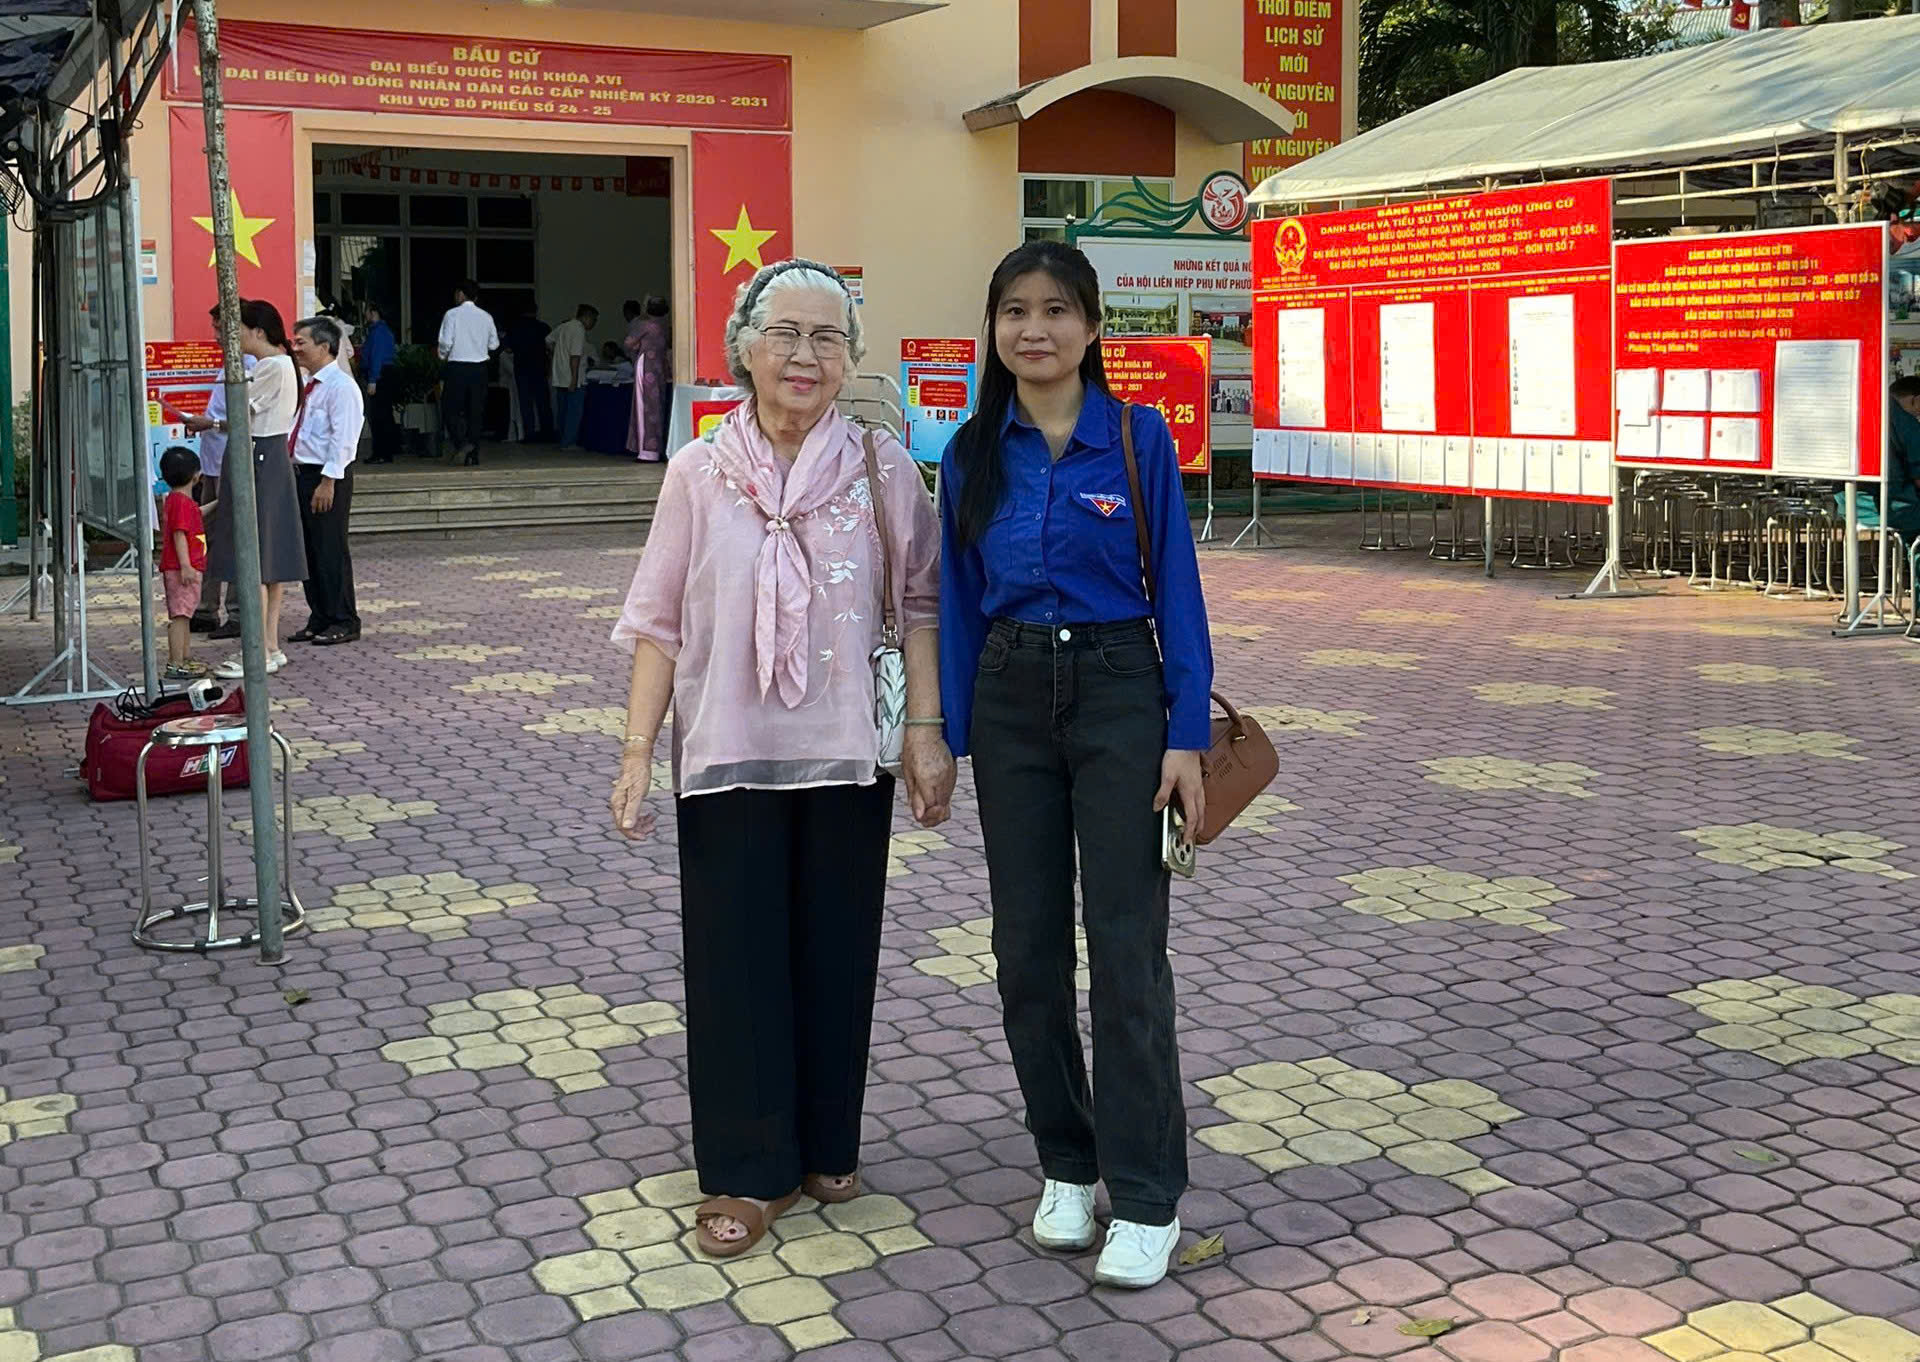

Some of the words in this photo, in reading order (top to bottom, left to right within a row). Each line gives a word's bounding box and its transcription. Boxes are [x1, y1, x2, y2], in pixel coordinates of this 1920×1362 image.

[1265, 26, 1299, 47] LỊCH
[1303, 23, 1325, 46] SỬ
[453, 44, 500, 64] BẦU
[508, 47, 542, 66] CỬ
[1279, 52, 1308, 73] MỚI
[370, 60, 402, 74] ĐẠI
[407, 61, 449, 75] BIỂU
[455, 64, 503, 79] QUỐC
[508, 68, 538, 82] HỘI
[543, 70, 590, 84] KHÓA
[595, 74, 624, 85] XVI
[224, 67, 259, 81] ĐẠI
[264, 67, 309, 83] BIỂU
[314, 71, 347, 88] HỘI
[352, 73, 404, 89] ĐỒNG
[409, 77, 461, 92] NHÂN
[466, 81, 504, 95] DÂN
[509, 83, 545, 97] CÁC
[550, 85, 585, 98] CẤP
[589, 88, 645, 103] NHIỆM
[649, 90, 671, 103] KỲ
[730, 95, 769, 107] 2031
[1275, 82, 1335, 102] NGUYÊN
[379, 94, 414, 106] KHU
[418, 95, 450, 109] VỰC
[454, 95, 477, 109] BỎ
[481, 98, 529, 112] PHIẾU
[534, 99, 555, 113] SỐ
[559, 103, 578, 114] 24
[592, 105, 613, 116] 25
[1296, 108, 1308, 129] ỚI
[1320, 225, 1347, 236] DANH
[1348, 221, 1375, 233] SÁCH
[1377, 218, 1391, 229] VÀ
[1392, 214, 1415, 228] TIỂU
[1418, 211, 1433, 225] SỬ
[1435, 210, 1459, 223] TÓM
[1485, 202, 1523, 217] NGƯỜI
[1525, 200, 1553, 213] ỨNG
[1555, 196, 1574, 209] CỬ
[1412, 203, 1445, 214] NIÊM
[1447, 198, 1472, 209] YẾT
[1173, 258, 1203, 272] NHỮNG
[1205, 257, 1221, 272] KẾT
[1223, 258, 1240, 272] QUẢ
[1116, 272, 1135, 288] CỦA
[1136, 274, 1151, 290] HỘI
[1153, 275, 1172, 288] LIÊN
[1174, 276, 1194, 290] HIỆP
[1196, 279, 1214, 292] PHỤ
[1215, 277, 1228, 289] NỮ
[1113, 345, 1126, 358] CỬ
[1174, 403, 1195, 424] 25
